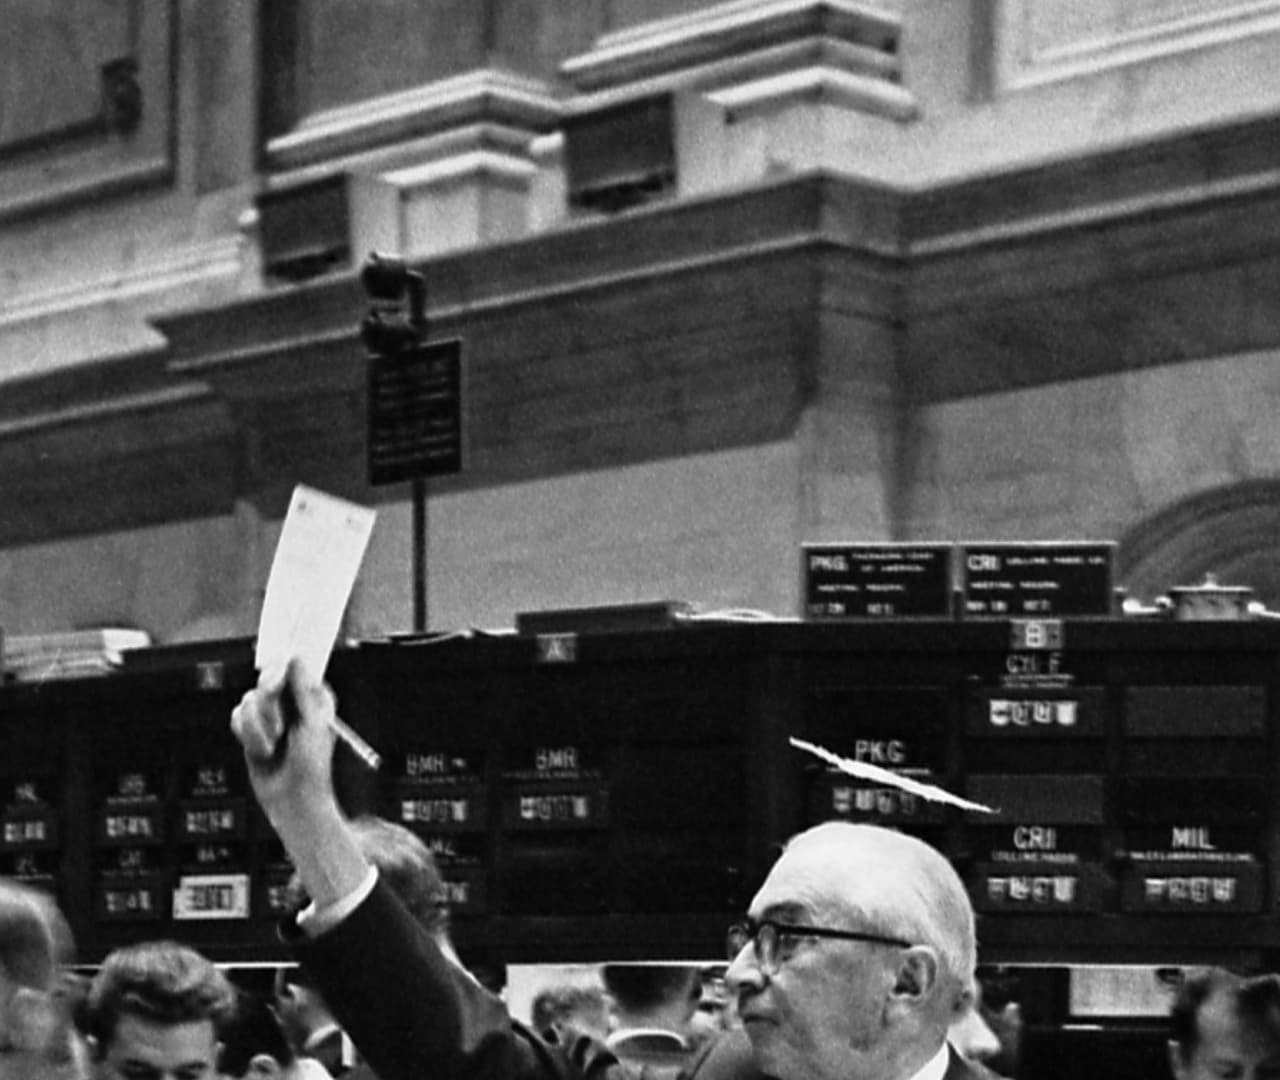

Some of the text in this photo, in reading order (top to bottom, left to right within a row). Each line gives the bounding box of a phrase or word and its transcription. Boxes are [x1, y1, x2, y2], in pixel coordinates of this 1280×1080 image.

[855, 740, 905, 763] PKG
[1013, 825, 1057, 850] CRI
[1171, 826, 1216, 850] MIL
